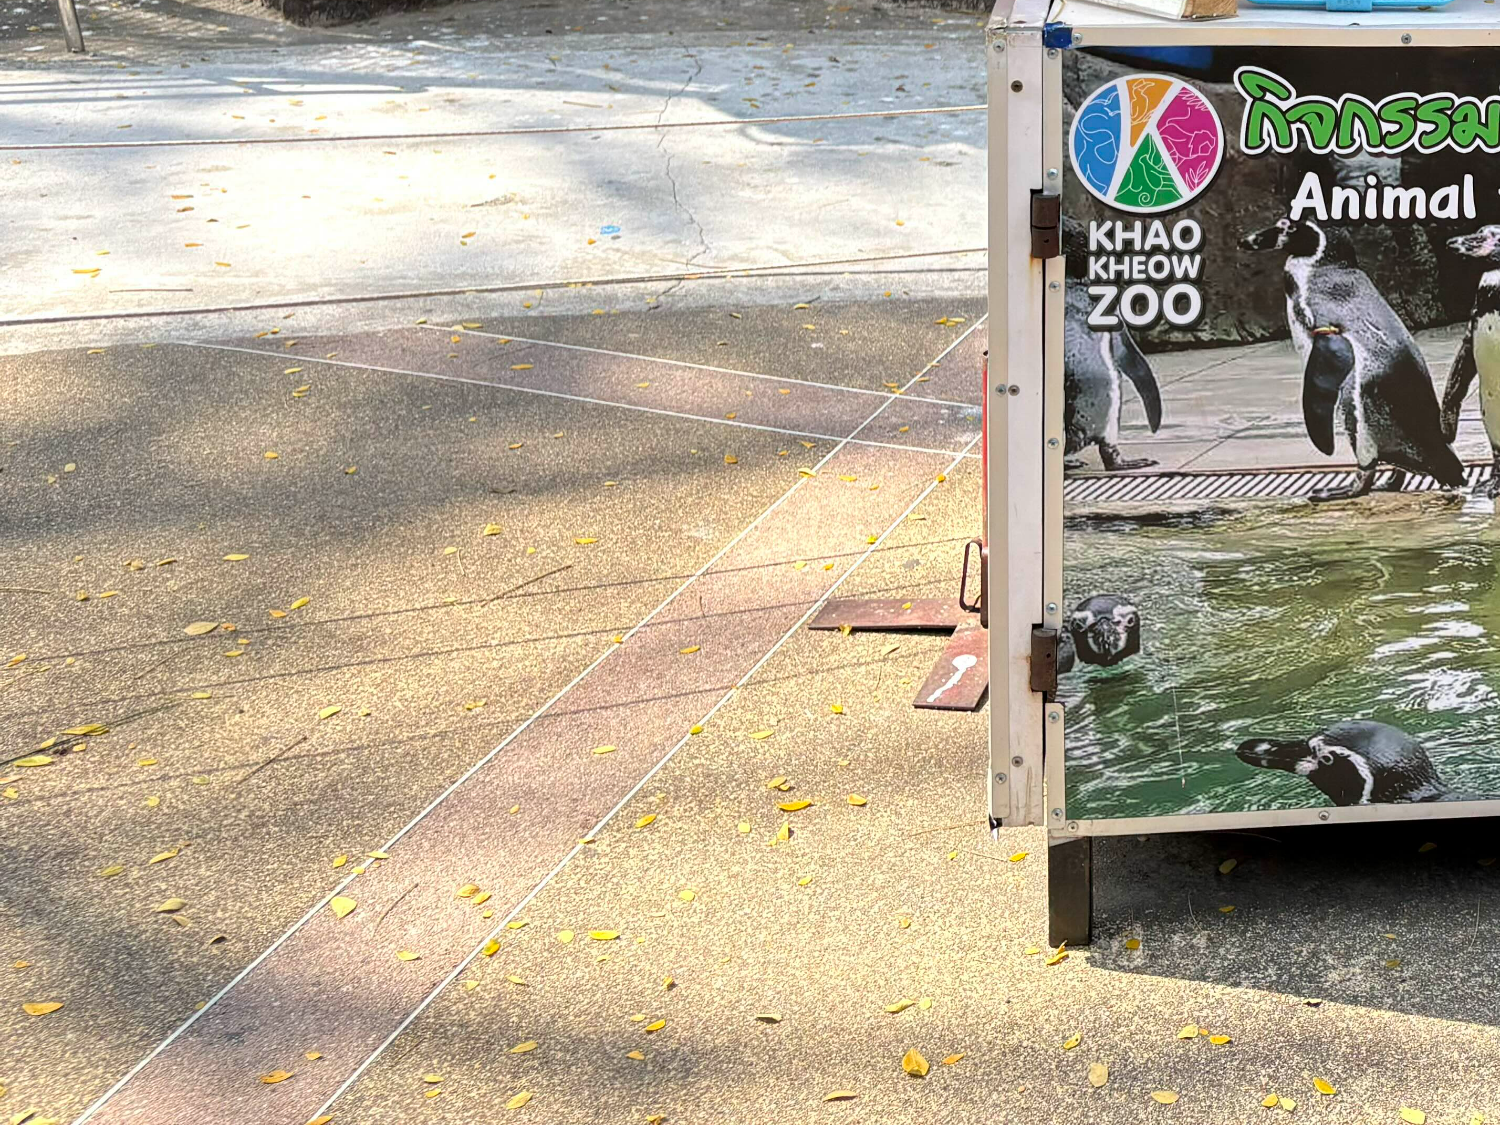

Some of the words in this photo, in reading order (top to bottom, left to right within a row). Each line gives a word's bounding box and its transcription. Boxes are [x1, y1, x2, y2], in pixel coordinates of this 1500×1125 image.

[1290, 171, 1476, 221] Animal
[1088, 218, 1202, 253] KHAO
[1088, 254, 1202, 281] KHEOW
[1087, 284, 1203, 327] ZOO
